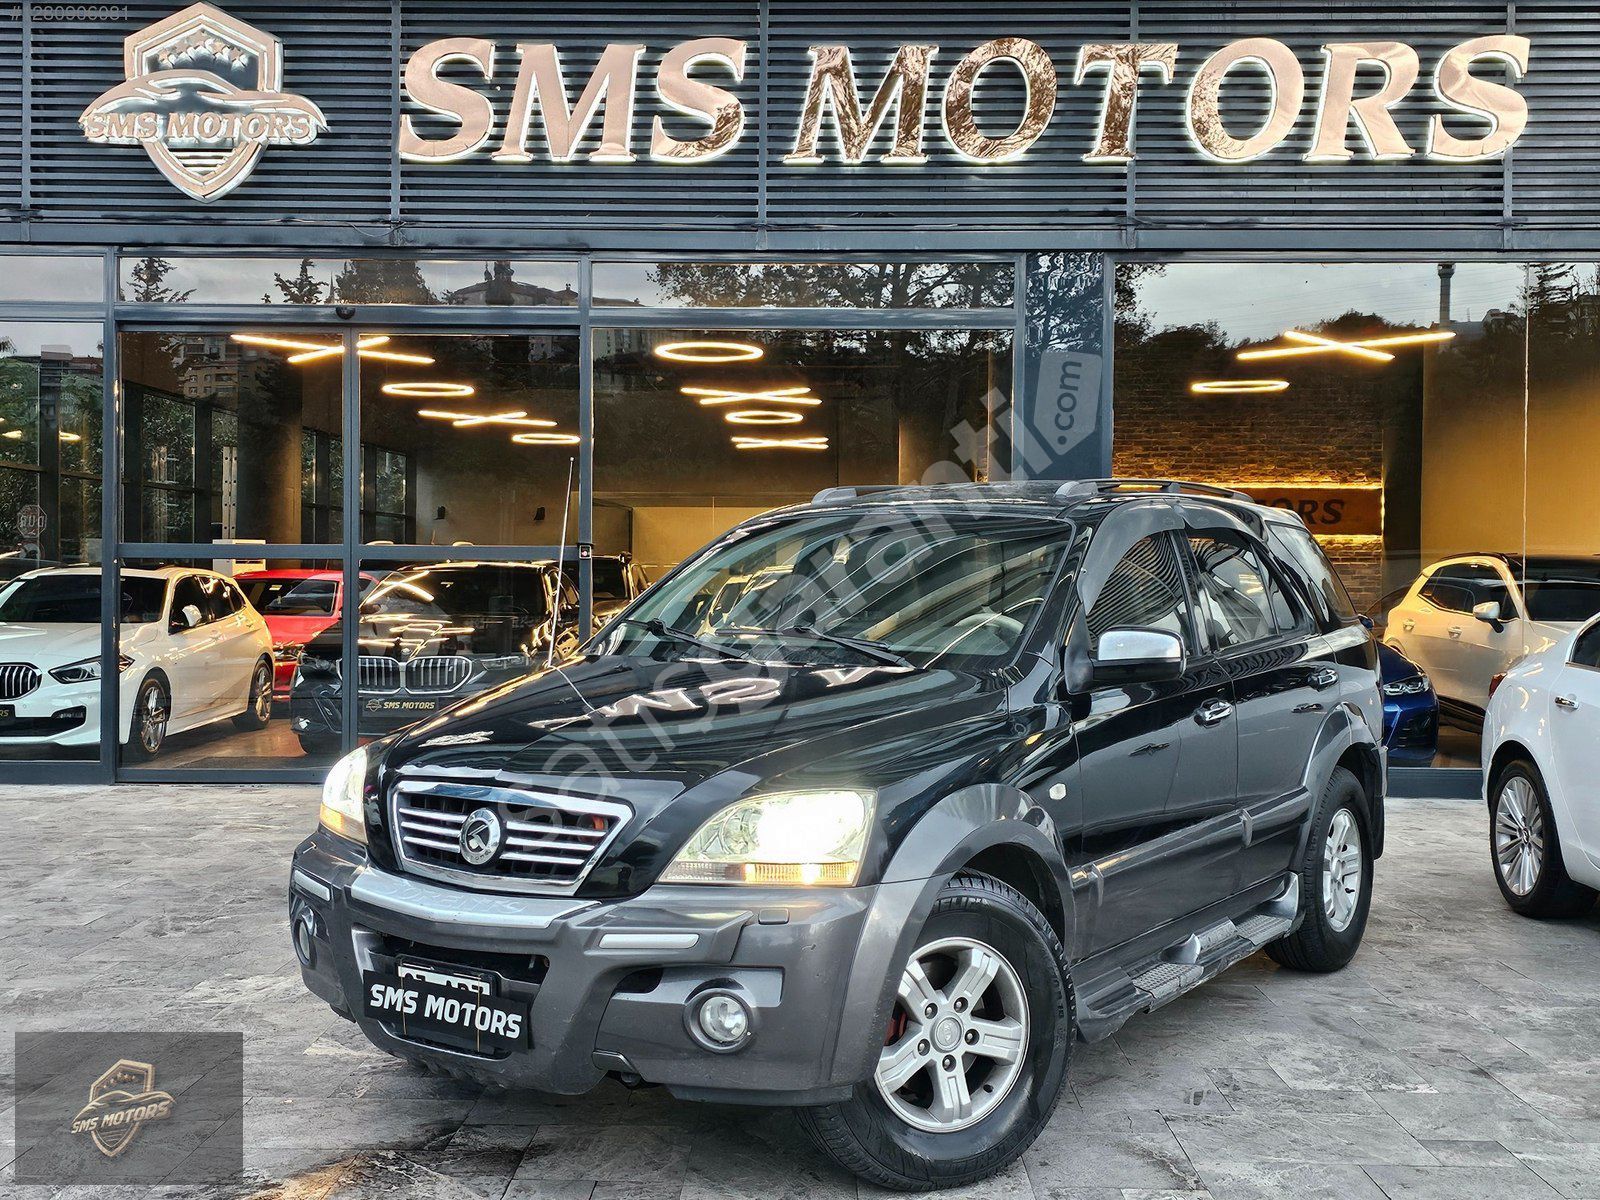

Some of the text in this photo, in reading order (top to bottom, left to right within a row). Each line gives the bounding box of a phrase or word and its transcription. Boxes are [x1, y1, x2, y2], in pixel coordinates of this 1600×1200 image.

[400, 36, 1531, 163] SMS MOTORS
[84, 112, 313, 141] SMS MOTORS
[383, 701, 400, 709] SMS
[402, 701, 435, 709] MOTORS
[370, 983, 419, 1015] SMS
[424, 994, 523, 1039] MOTORS
